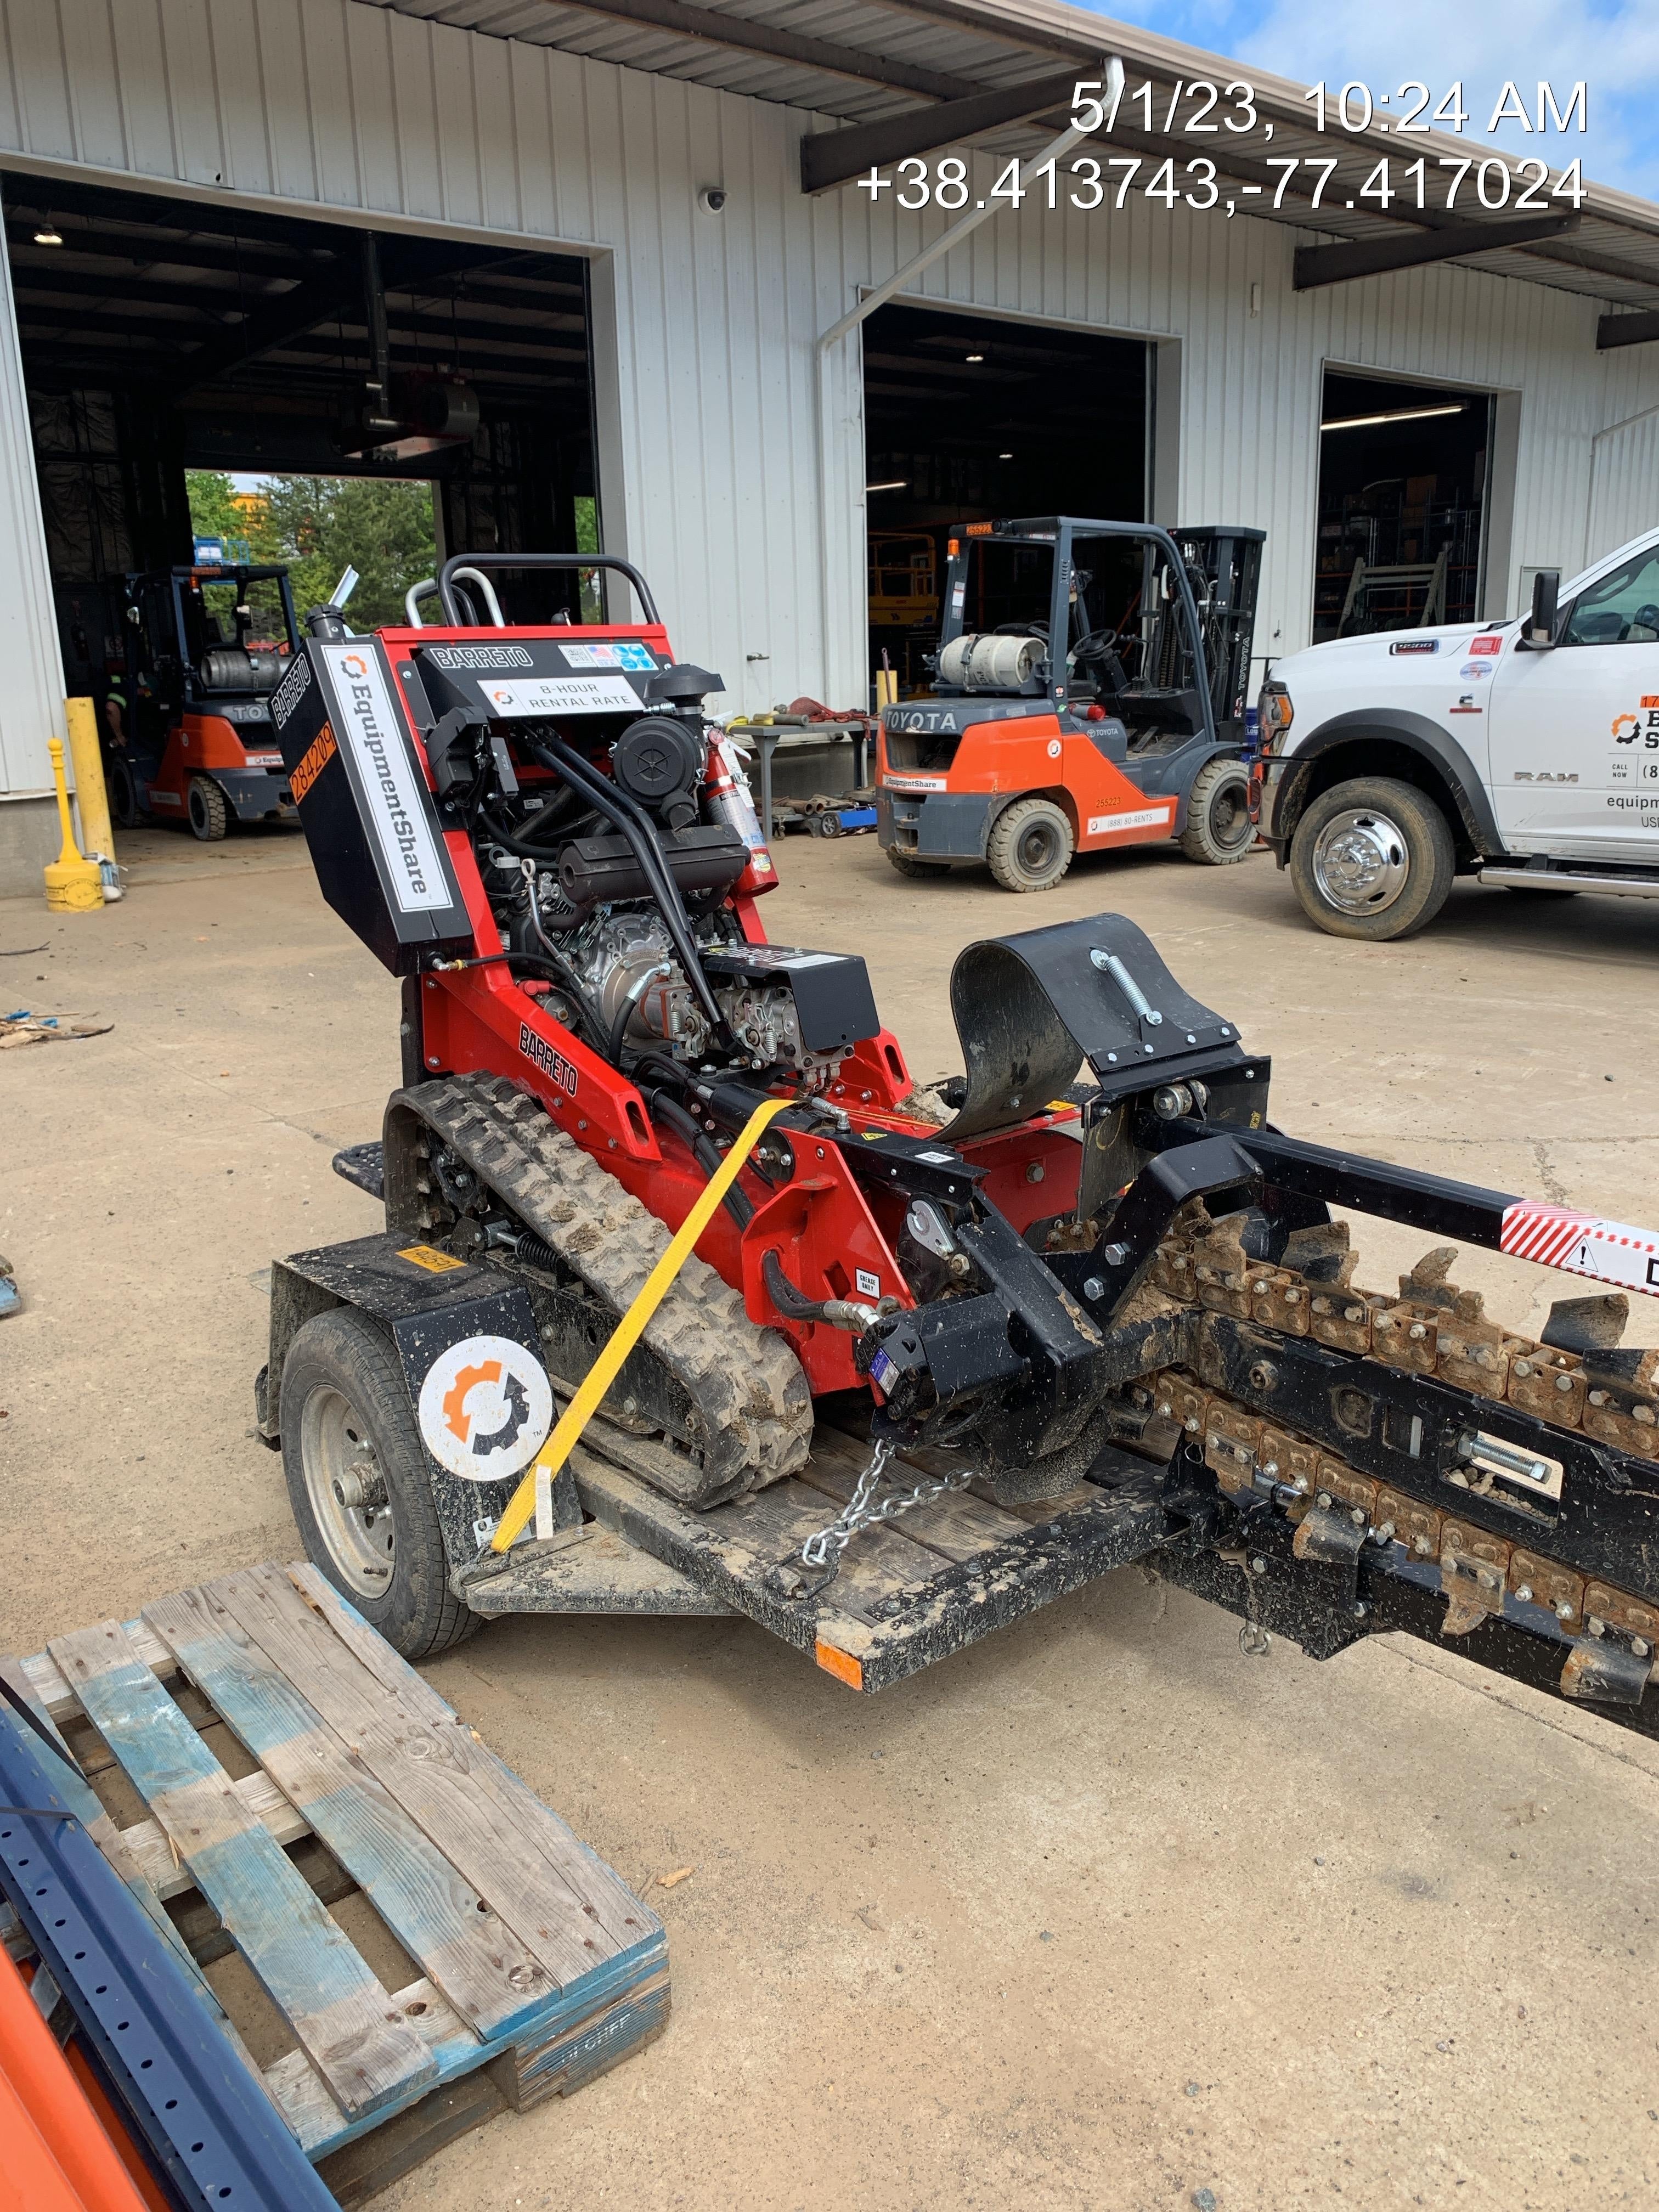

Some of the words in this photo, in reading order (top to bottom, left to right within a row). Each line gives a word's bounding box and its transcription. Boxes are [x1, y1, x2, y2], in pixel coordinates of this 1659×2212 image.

[430, 646, 533, 668] BARRETO
[1238, 636, 1250, 690] TOYOTA
[270, 652, 311, 730] BARRETO
[540, 684, 600, 693] 8-HOUR
[528, 697, 589, 708] RENTAL
[591, 696, 631, 706] RATE
[886, 711, 957, 730] TOYOTA
[291, 725, 334, 800] 284209
[1514, 772, 1578, 782] RAM
[351, 684, 427, 894] EquipmentShare
[1096, 797, 1121, 808] 255223
[1107, 819, 1122, 828] (888)
[1124, 814, 1152, 825] 80-RENTS
[1641, 816, 1659, 827] US
[519, 1021, 578, 1097] BARRETO
[860, 1274, 876, 1286] GREASE
[862, 1282, 873, 1291] DAILY
